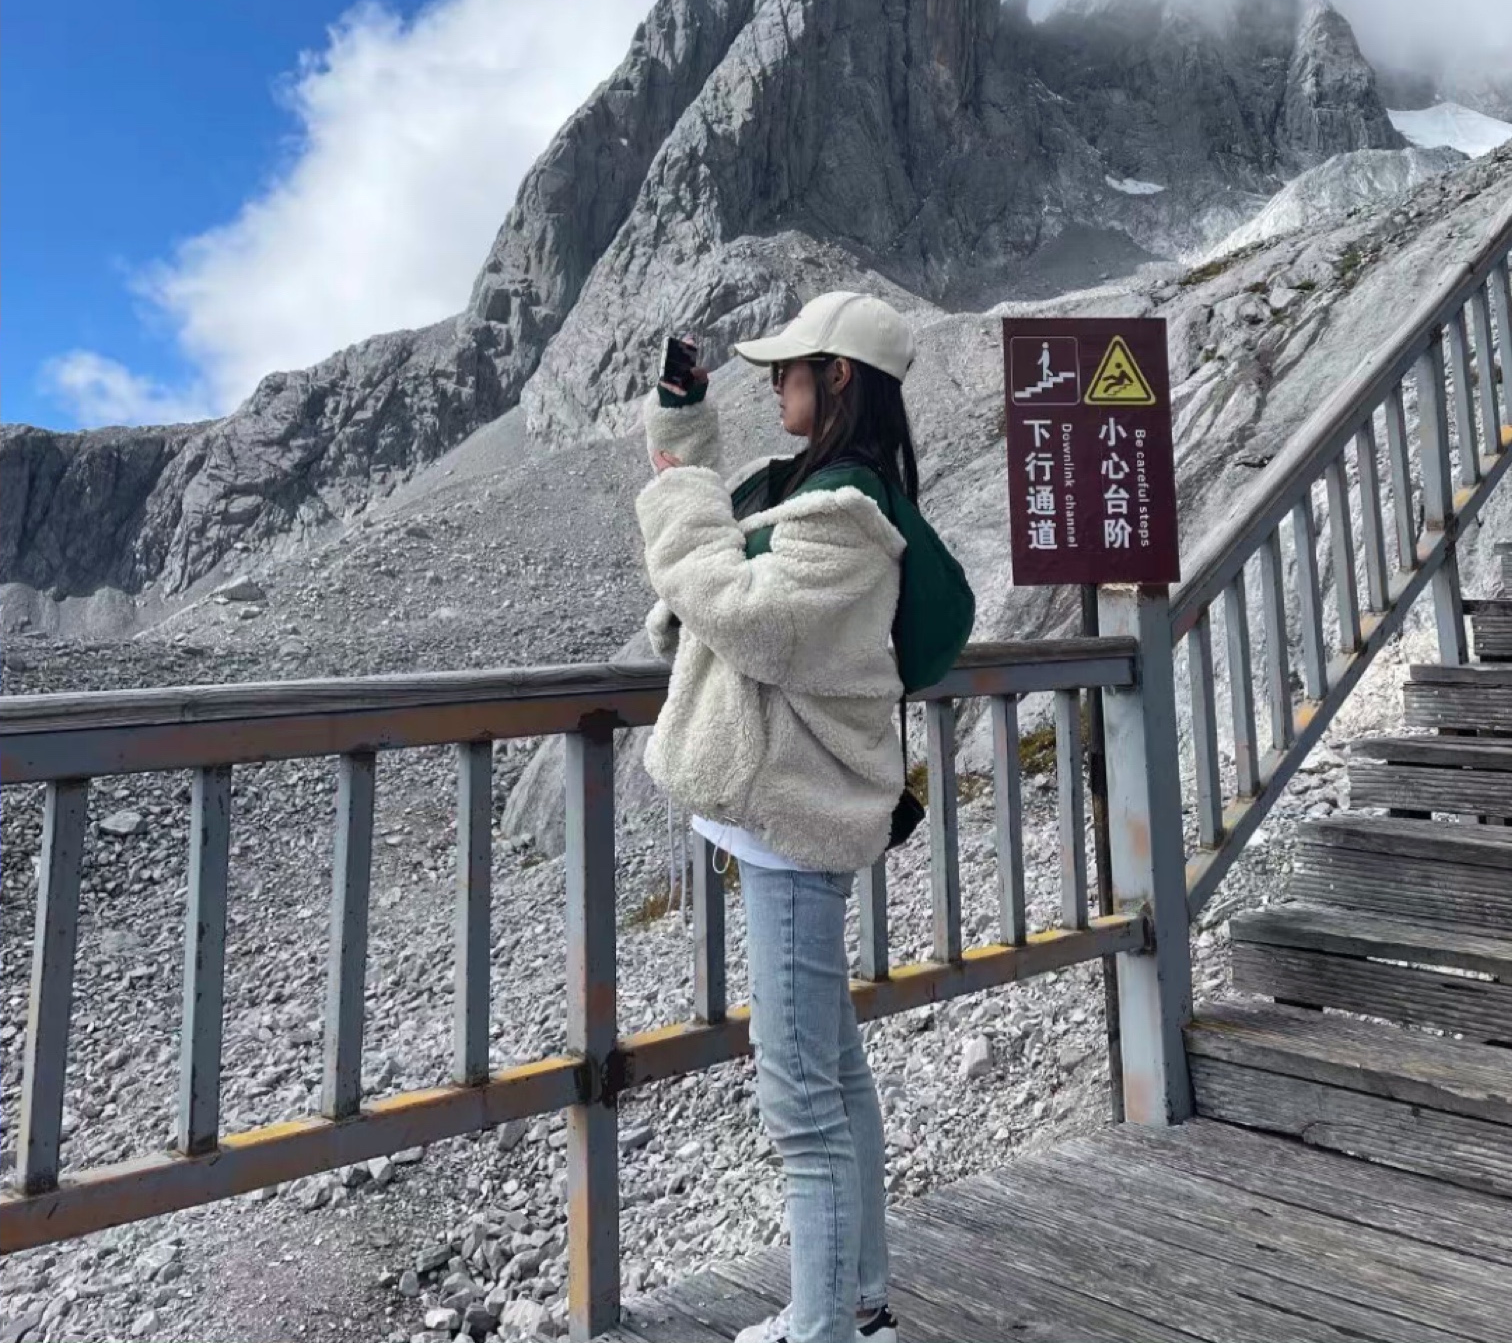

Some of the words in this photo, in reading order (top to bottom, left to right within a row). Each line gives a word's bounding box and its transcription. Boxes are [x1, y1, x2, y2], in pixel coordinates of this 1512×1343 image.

[1061, 422, 1076, 488] Downlink
[1135, 428, 1147, 448] Be
[1023, 419, 1058, 550] 下行通道
[1098, 417, 1133, 549] 小心台阶
[1136, 451, 1151, 503] careful
[1065, 493, 1079, 548] channel
[1138, 505, 1150, 548] steps
